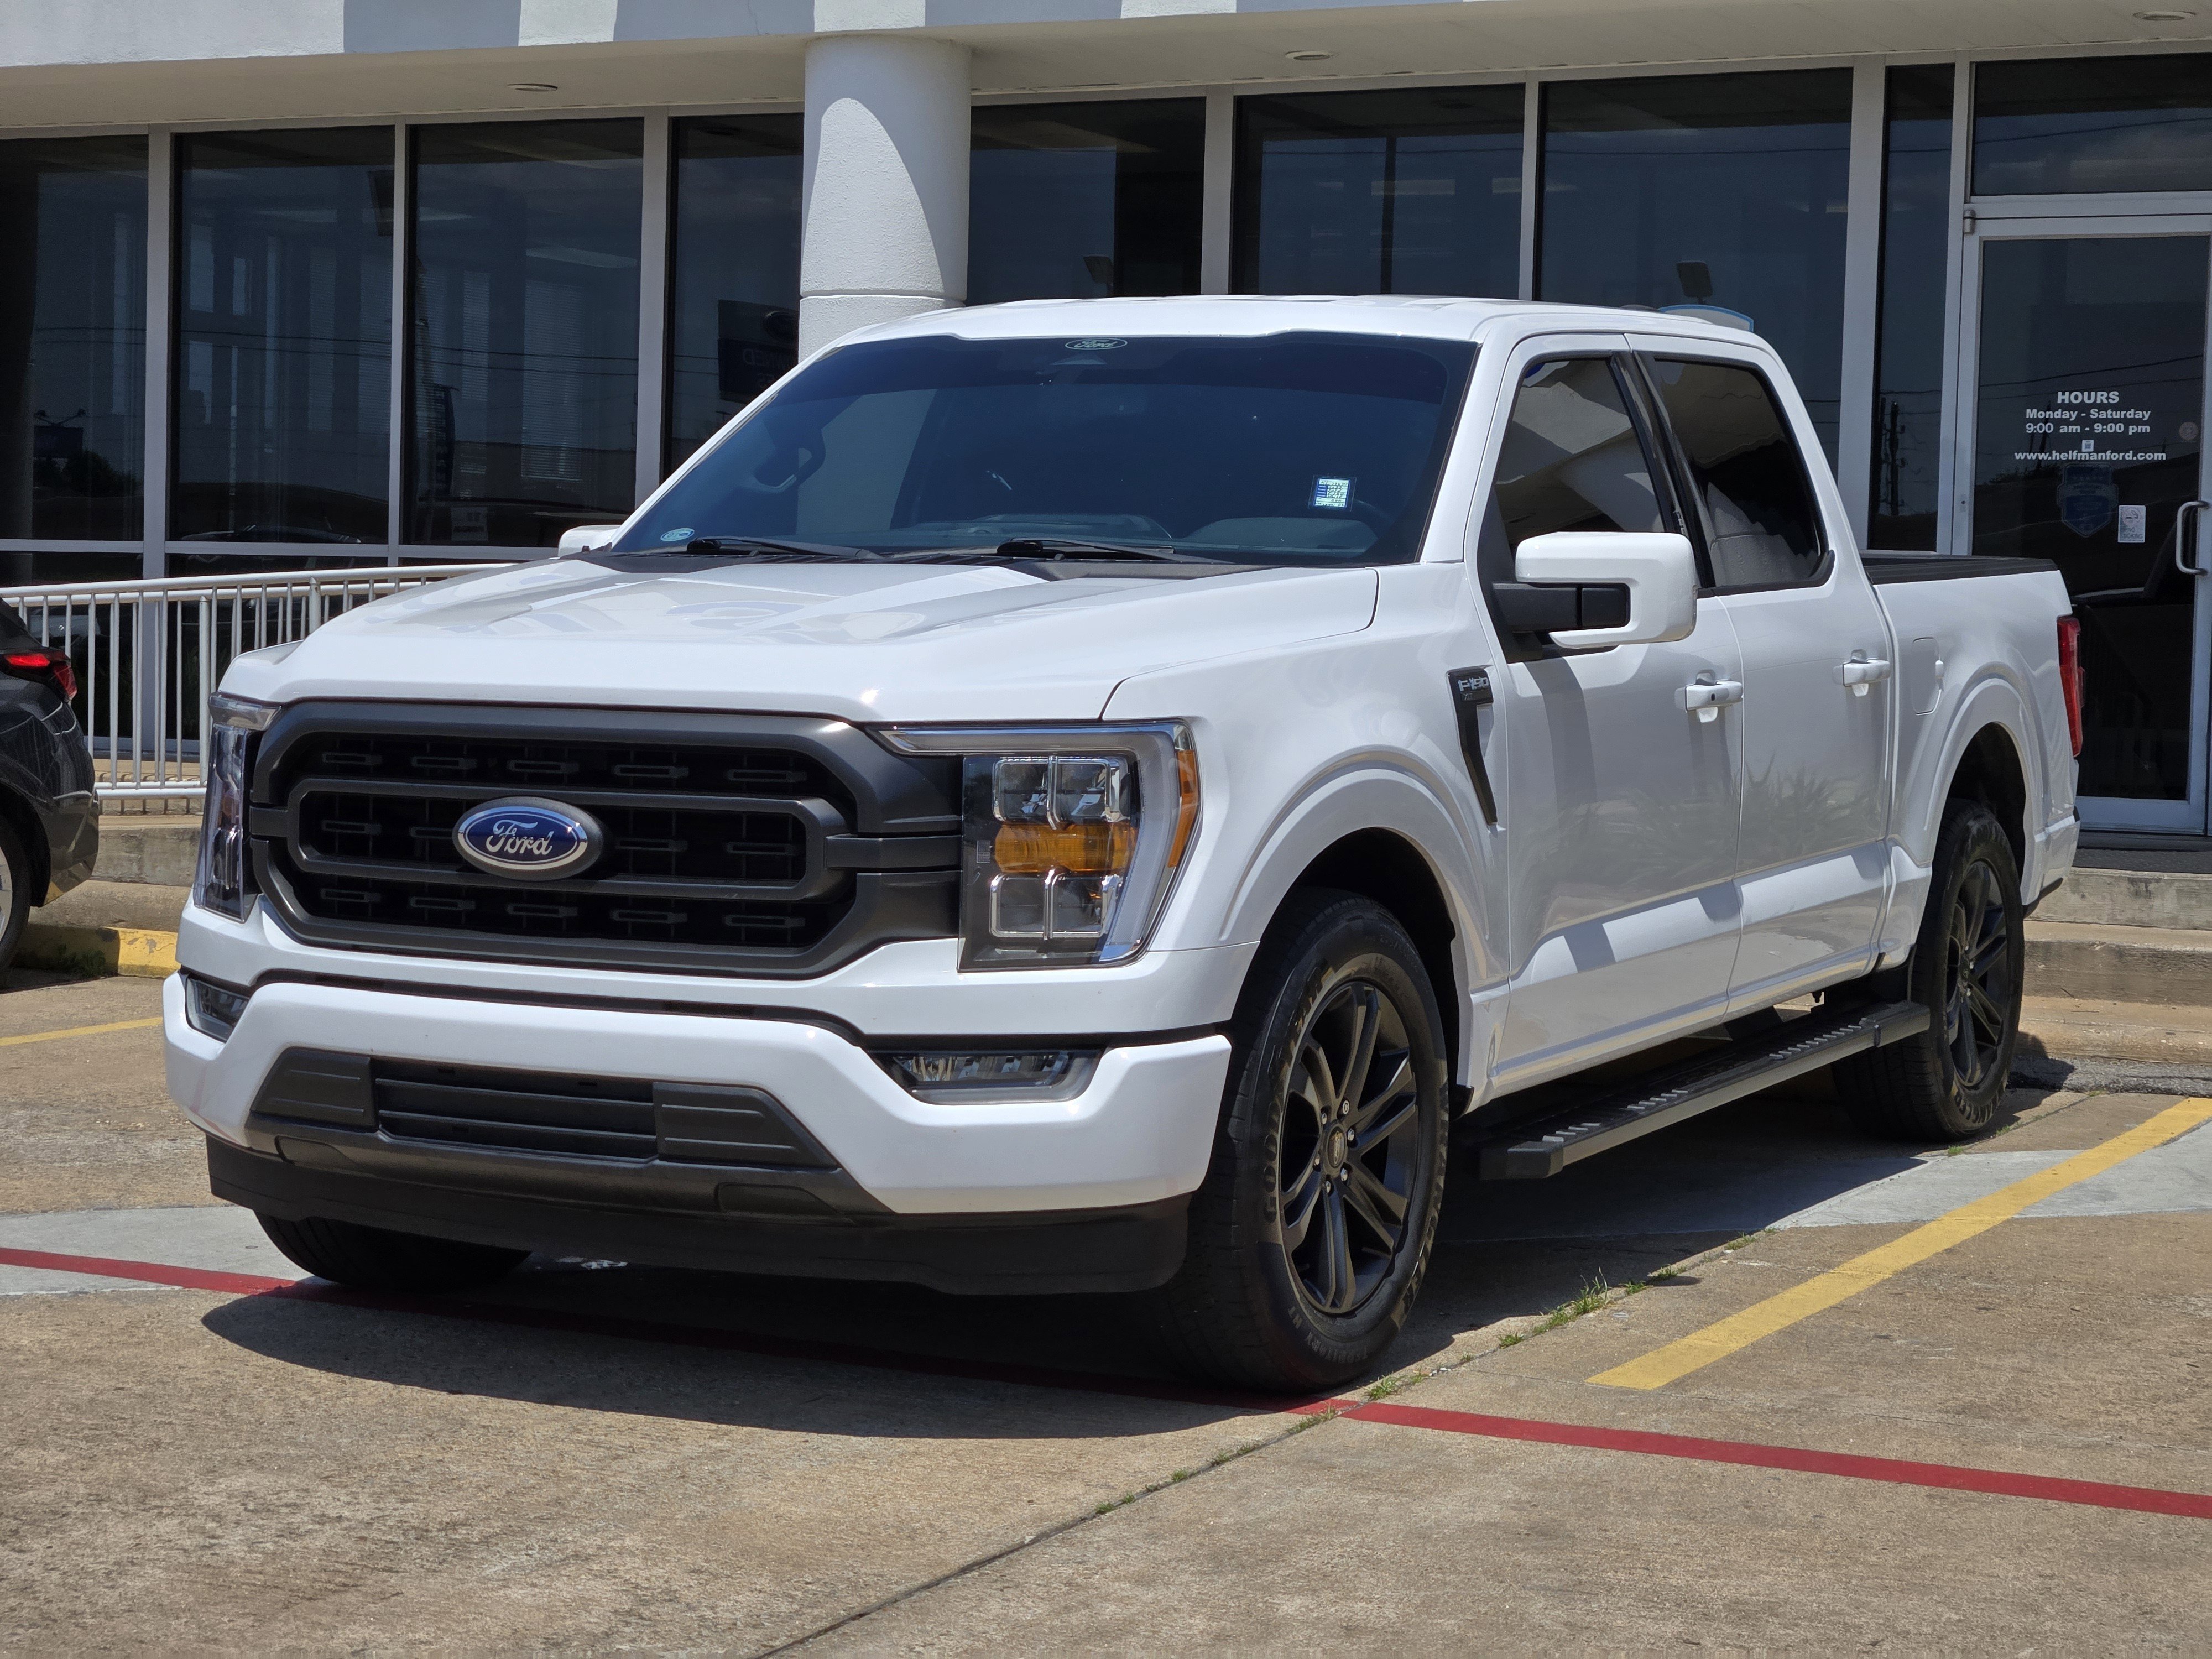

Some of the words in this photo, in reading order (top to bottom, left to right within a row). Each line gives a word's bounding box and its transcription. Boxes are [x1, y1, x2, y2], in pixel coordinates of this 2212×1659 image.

[1074, 338, 1118, 348] Ford
[2057, 391, 2120, 404] HOURS
[2026, 408, 2078, 421] Monday
[2089, 408, 2151, 420] Saturday
[2025, 422, 2054, 433] 9:00
[2094, 422, 2124, 433] 9:00
[2128, 425, 2150, 435] pm
[2014, 450, 2166, 461] www.helfmanford.com
[486, 819, 555, 855] Ford
